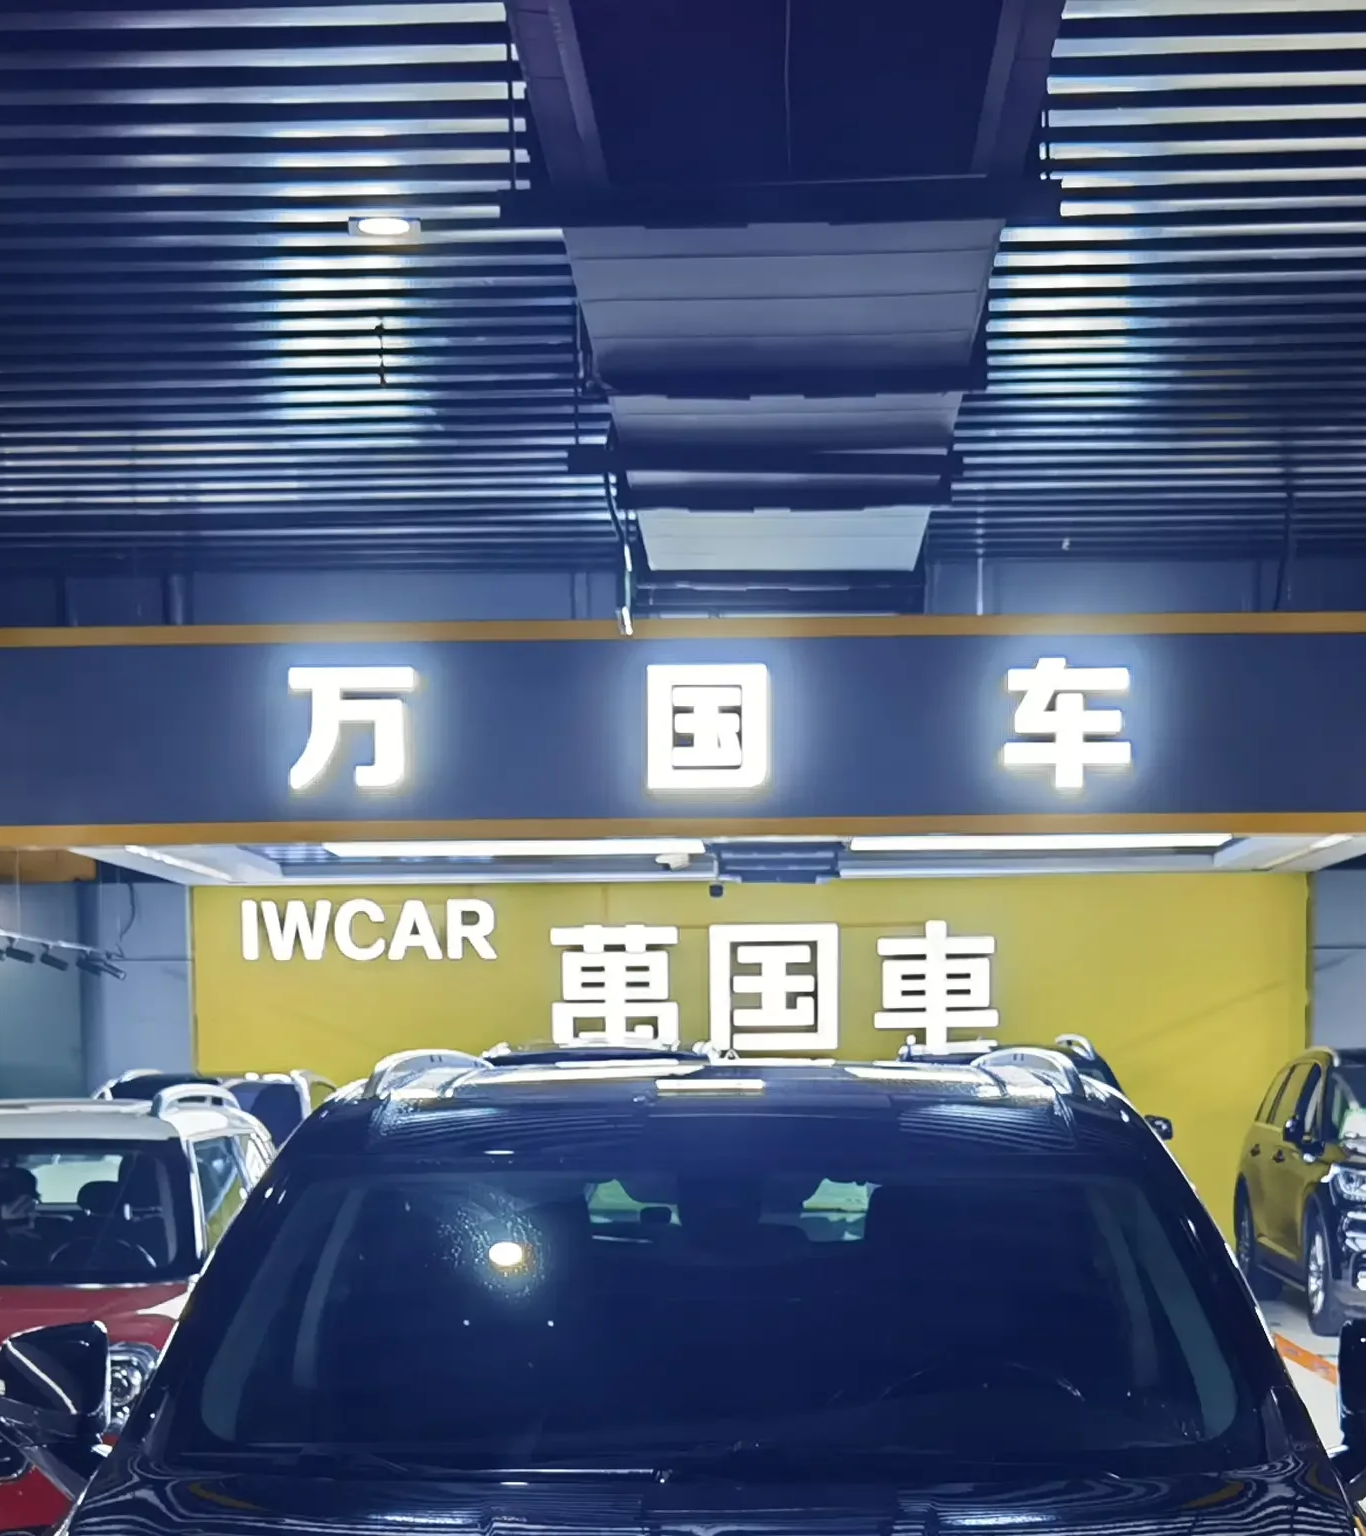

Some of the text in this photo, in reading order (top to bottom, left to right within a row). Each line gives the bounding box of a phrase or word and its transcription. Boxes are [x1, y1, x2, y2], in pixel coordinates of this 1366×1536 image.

[288, 656, 1133, 790] 万国车
[240, 898, 498, 962] IWCAR
